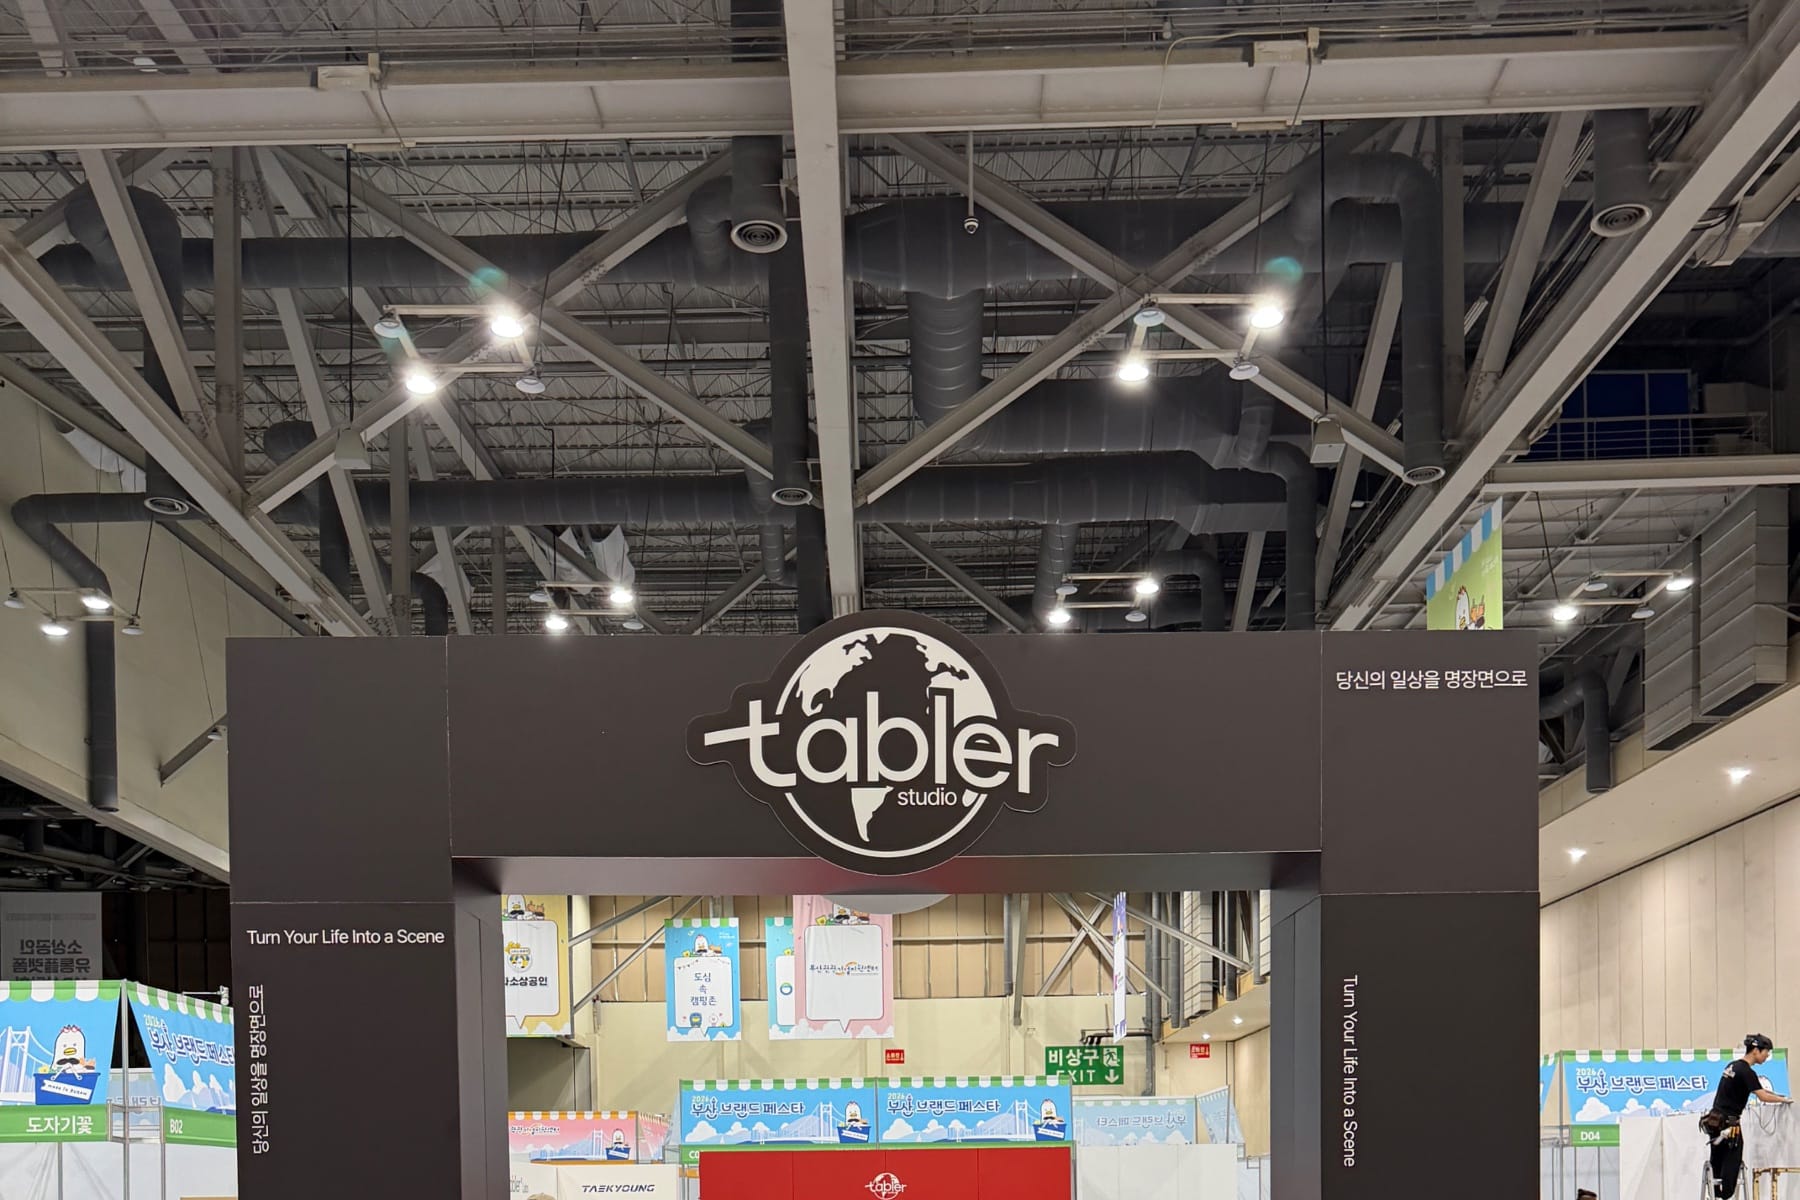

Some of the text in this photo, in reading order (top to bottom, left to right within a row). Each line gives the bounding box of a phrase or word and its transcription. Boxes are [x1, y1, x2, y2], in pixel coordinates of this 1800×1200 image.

[1336, 669, 1529, 690] 당신의 일상을 명장면으로
[704, 690, 1059, 794] tabler
[897, 787, 957, 806] studio
[246, 928, 445, 945] Turn Your Life Into a Scene
[694, 972, 711, 982] 도심
[1048, 1048, 1100, 1067] 비상구
[248, 984, 270, 1154] 당신의 일상을 명장면으로
[1343, 975, 1358, 1167] Turn Your Life Into a Scene
[1576, 1068, 1597, 1076] 2026
[1577, 1070, 1709, 1095] 부산 브랜드 페스타
[691, 1097, 806, 1119] 부산 브랜드 페스타
[887, 1094, 1001, 1117] 부산 브랜드 페스타
[26, 1115, 94, 1135] 도자기꽃
[169, 1119, 183, 1134] B02
[1580, 1131, 1600, 1142] D04
[582, 1184, 655, 1193] TAEKYOUNG
[864, 1180, 907, 1193] tabler
